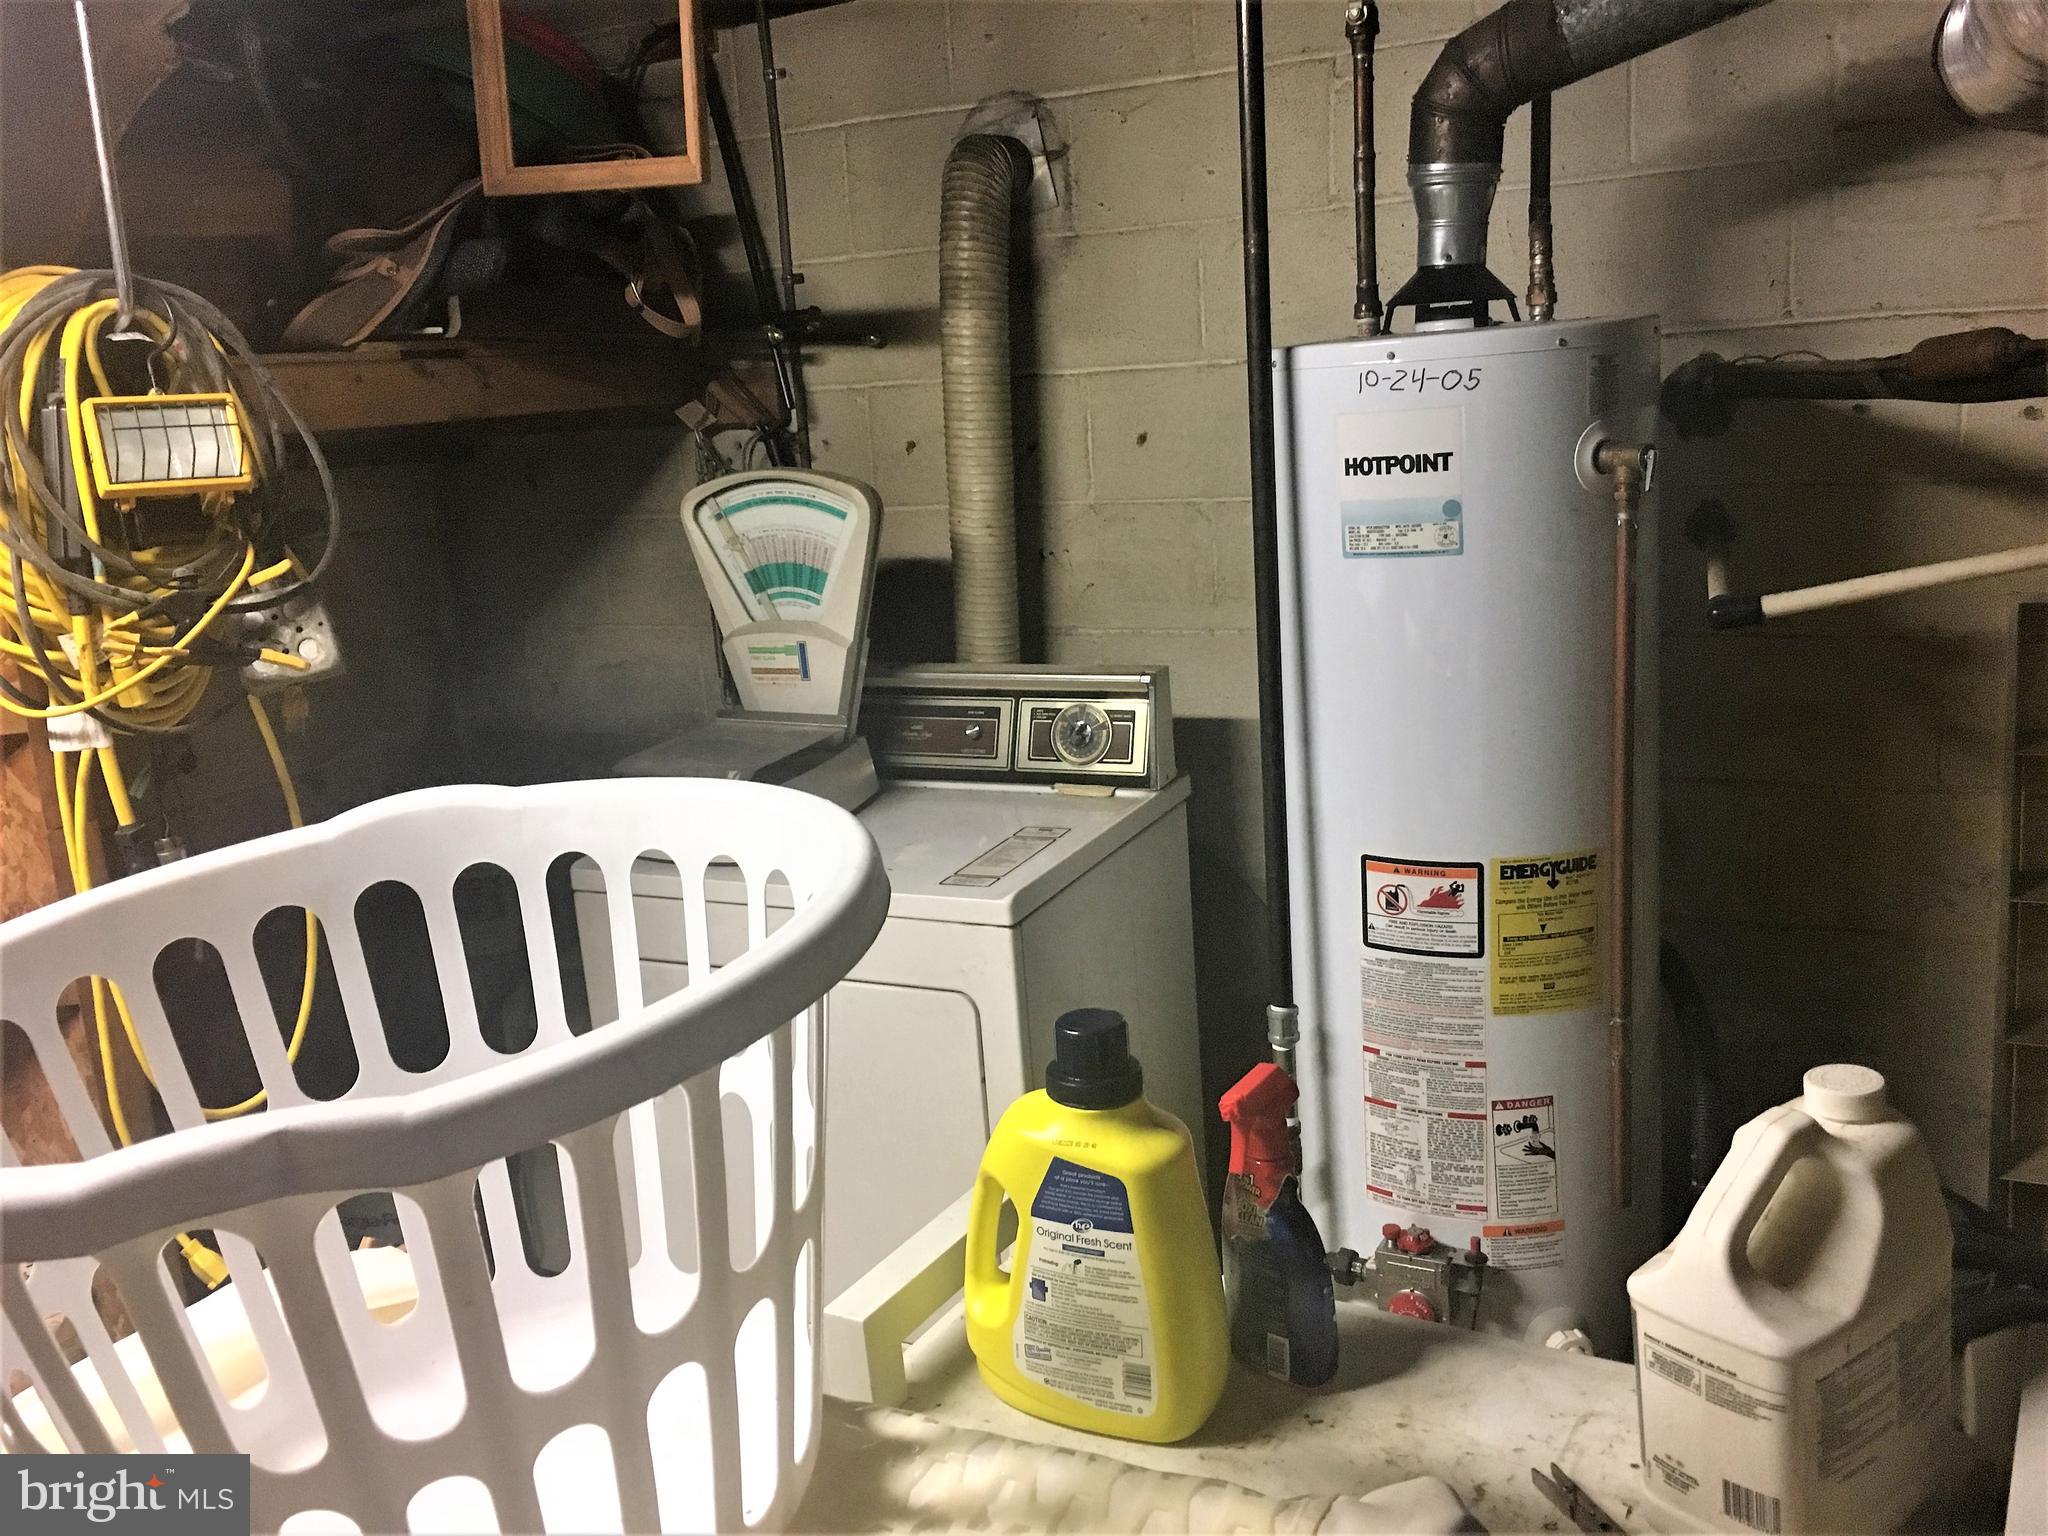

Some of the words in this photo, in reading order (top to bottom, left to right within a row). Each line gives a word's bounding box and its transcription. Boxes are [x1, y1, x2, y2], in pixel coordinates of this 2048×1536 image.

[1359, 367, 1482, 394] 10-24-05
[1344, 452, 1453, 476] HOTPOINT
[1404, 868, 1447, 877] WARNING
[1507, 1098, 1550, 1109] DANGER
[1075, 1219, 1090, 1231] he
[1036, 1226, 1074, 1243] Original
[1076, 1234, 1102, 1247] Fresh
[1104, 1238, 1132, 1251] Scent
